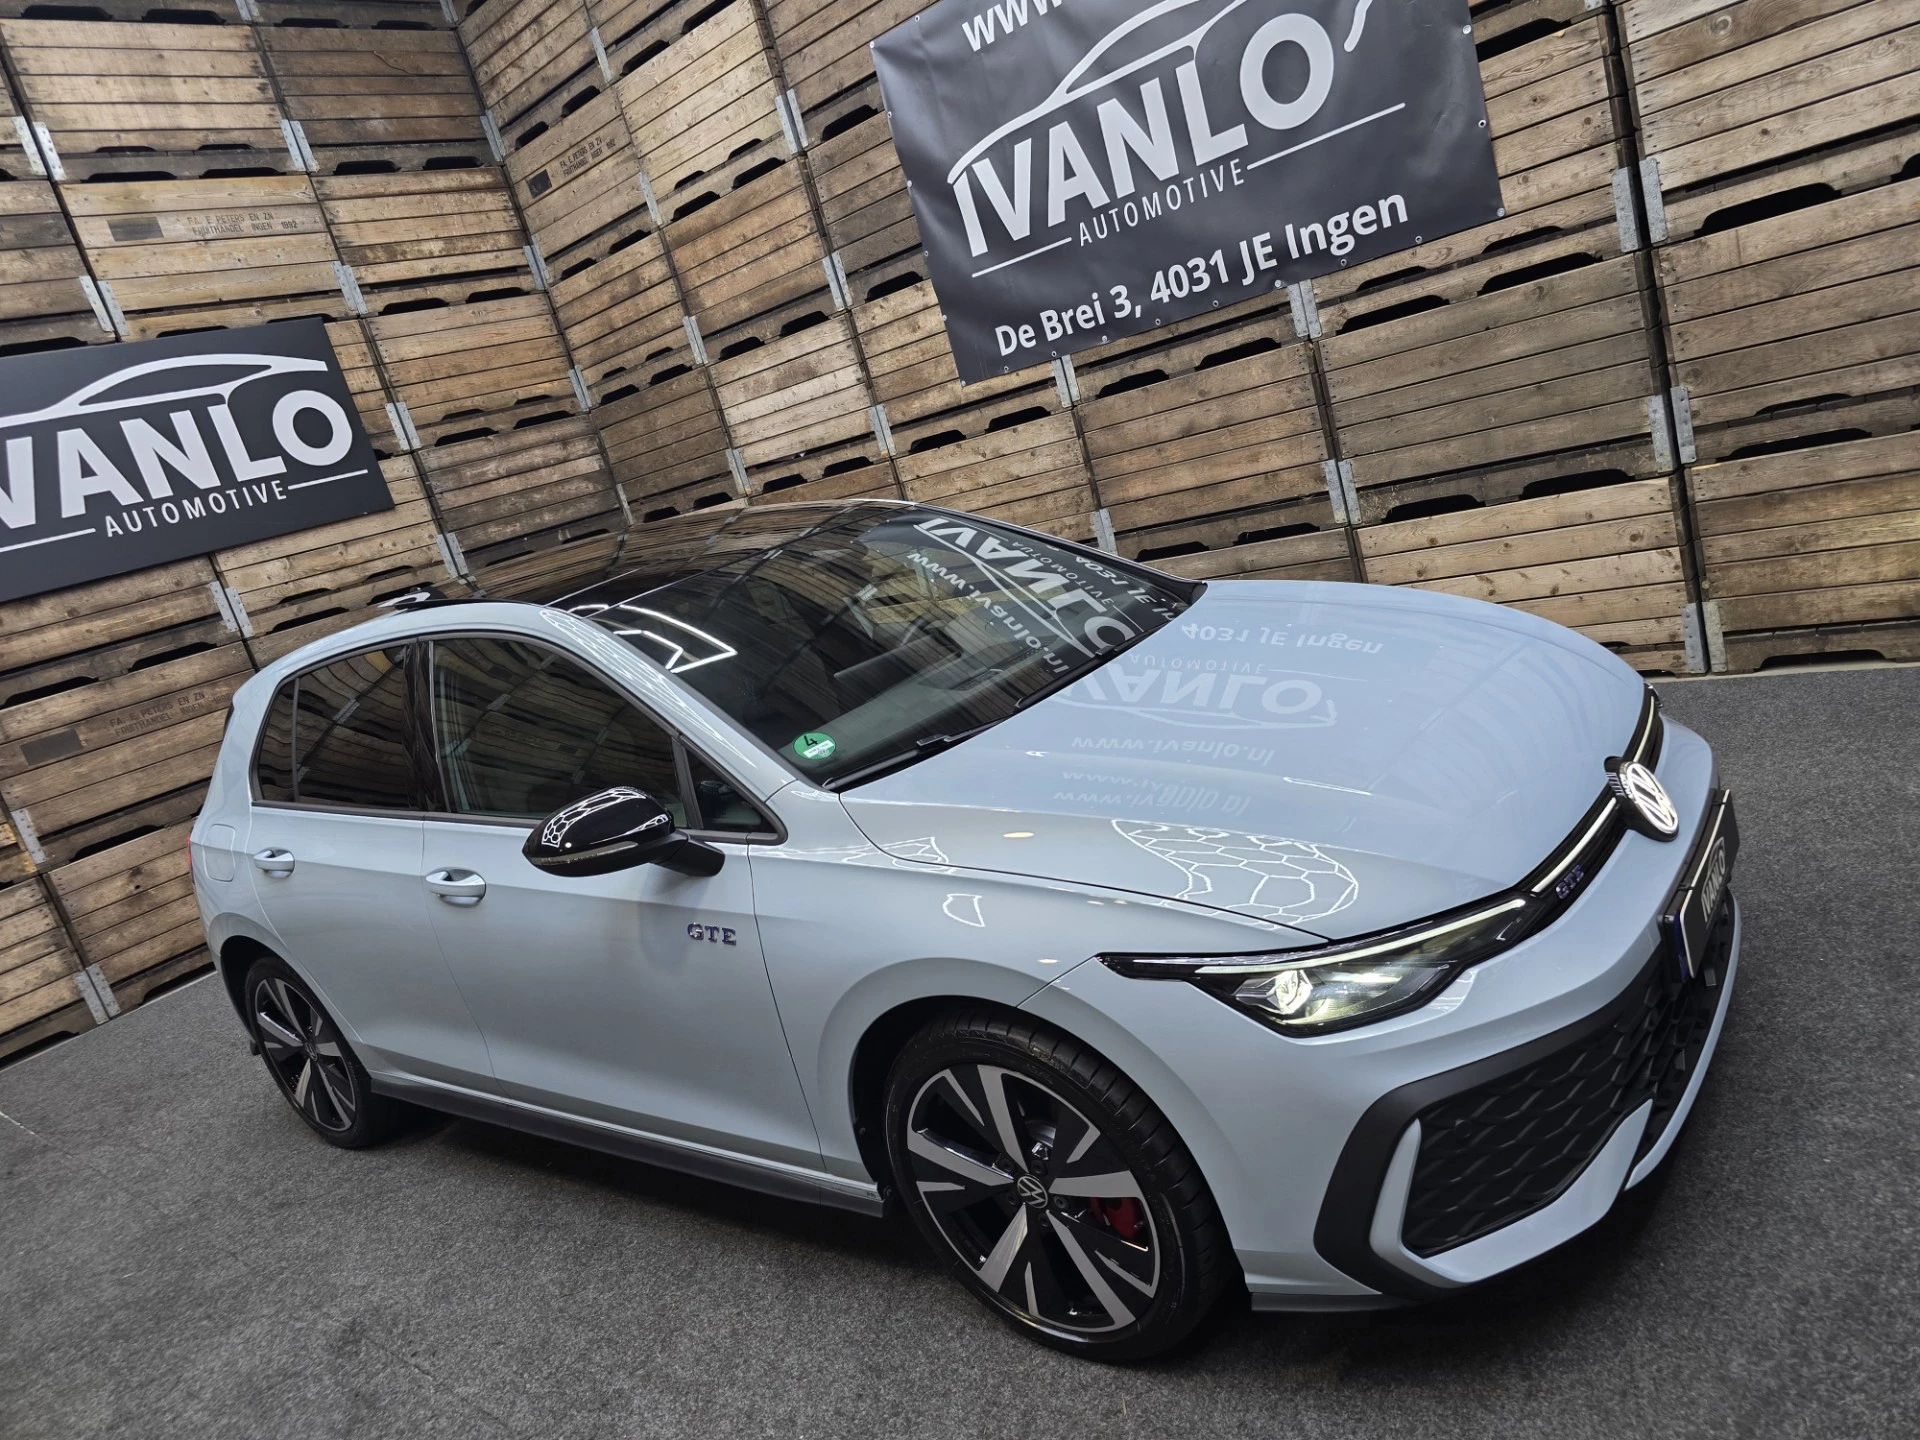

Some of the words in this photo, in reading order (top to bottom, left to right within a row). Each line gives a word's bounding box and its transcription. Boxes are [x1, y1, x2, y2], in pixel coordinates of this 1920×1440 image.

[952, 13, 1334, 257] IVANLO
[1079, 158, 1244, 247] AUTOMOTIVE
[192, 221, 244, 236] FRUITHANDEL
[251, 221, 273, 231] INGEN
[216, 214, 245, 223] PETERS
[249, 213, 260, 222] EN
[264, 212, 274, 220] ZN
[995, 322, 1036, 357] De
[1040, 293, 1105, 342] Brei
[1109, 284, 1142, 319] 3,
[1151, 249, 1228, 304] 4031
[1238, 232, 1277, 287] JE
[1285, 193, 1408, 260] Ingen
[105, 480, 287, 537] AUTOMOTIVE
[140, 701, 173, 717] PETERS
[178, 695, 190, 706] EN
[193, 690, 205, 701] ZN
[180, 702, 204, 715] INGEN
[804, 735, 818, 746] 4
[1555, 864, 1584, 900] GTE
[687, 922, 737, 947] GTE
